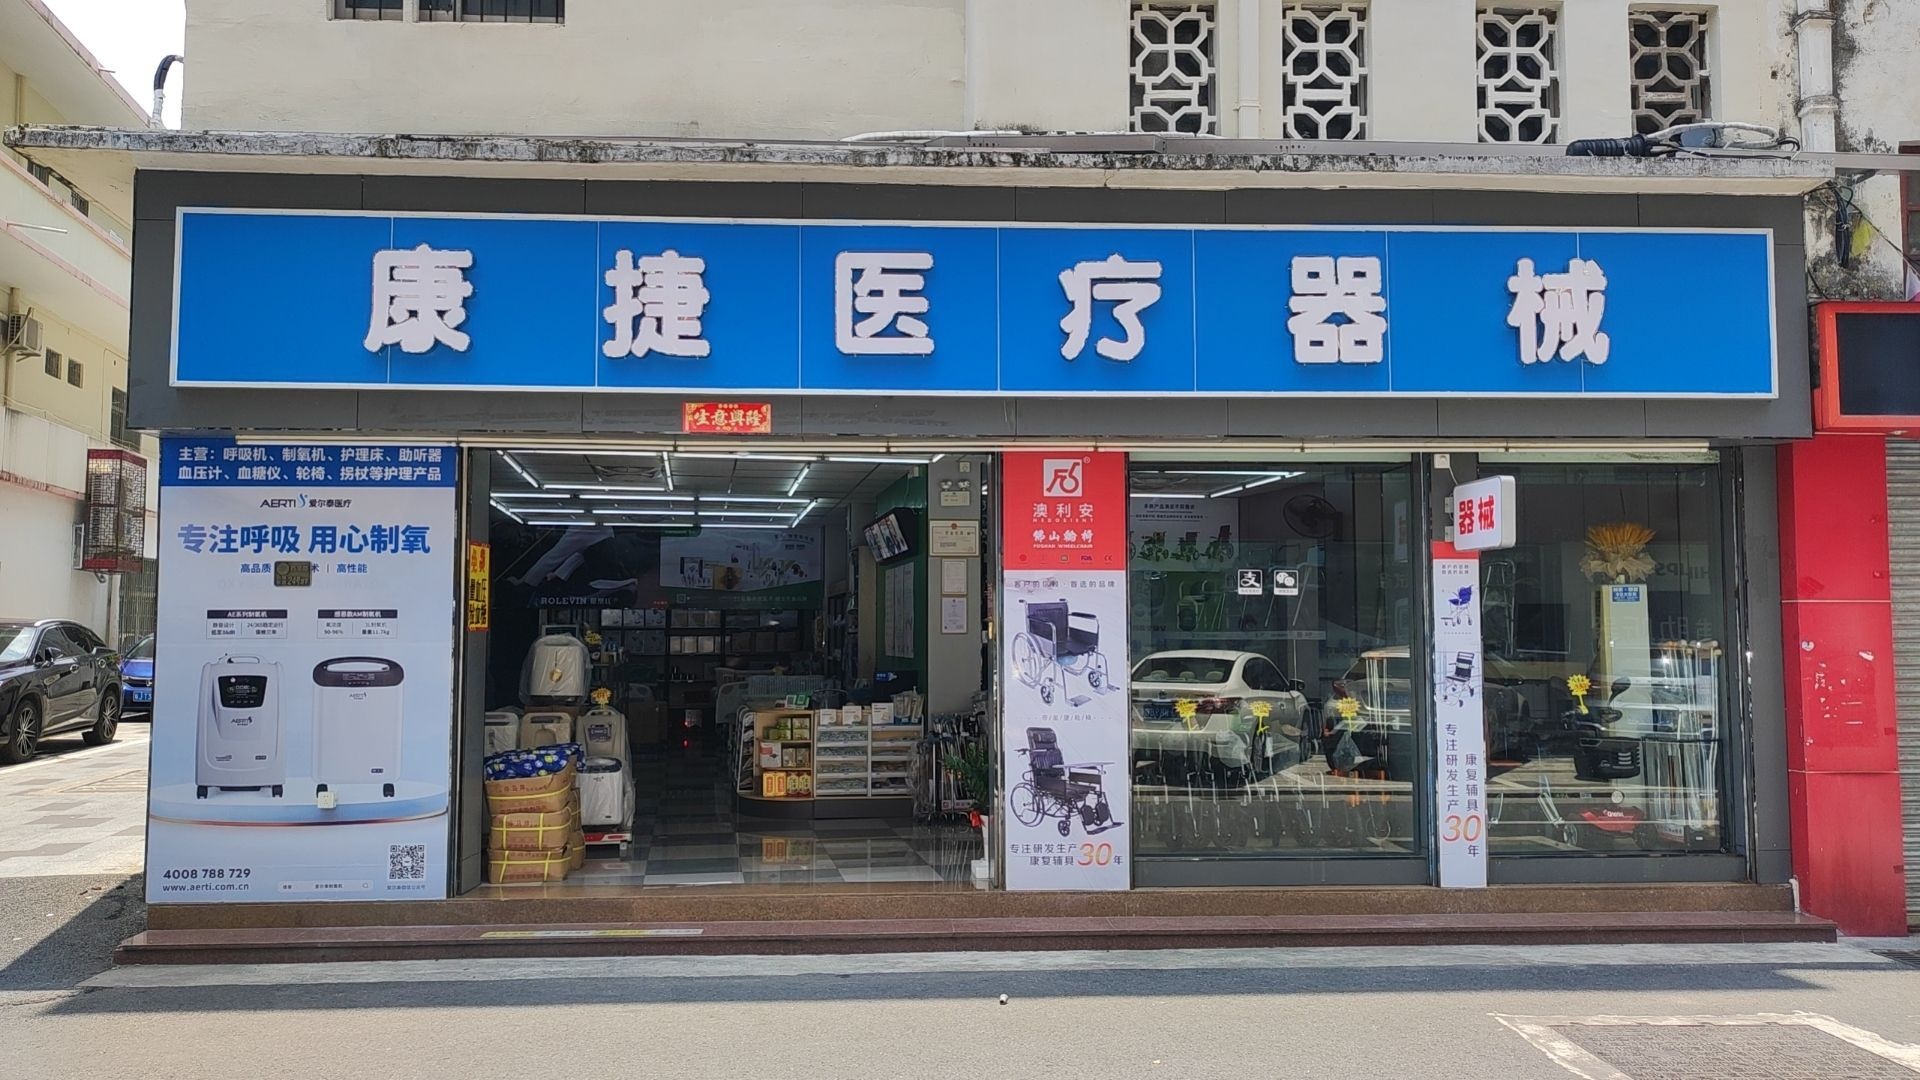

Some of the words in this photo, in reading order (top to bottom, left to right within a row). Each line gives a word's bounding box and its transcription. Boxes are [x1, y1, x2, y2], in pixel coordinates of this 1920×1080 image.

[363, 242, 1611, 367] 康捷医疗器械
[177, 465, 442, 482] 血压计、血糖仪、轮椅、拐杖等护理产品
[308, 498, 352, 509] 爱尔泰医疗
[1033, 503, 1094, 518] 澳利安
[1458, 494, 1496, 536] 器械
[177, 523, 301, 554] 专注呼吸
[308, 523, 431, 554] 用心制氧
[240, 562, 272, 574] 高品质
[336, 562, 368, 574] 高性能
[540, 597, 587, 605] ROLEVIN
[1444, 722, 1461, 812] 专注研发生产
[1464, 753, 1480, 812] 康复辅具
[1442, 814, 1483, 843] 30
[1010, 843, 1078, 854] 专注研发生产
[1077, 842, 1114, 868] 30
[1113, 855, 1124, 866] 年
[1467, 844, 1480, 858] 年
[1029, 855, 1075, 866] 康复辅具
[163, 869, 198, 880] 4008
[201, 868, 225, 879] 788
[228, 868, 252, 879] 729
[162, 882, 250, 892] www.aerti.com.cn
